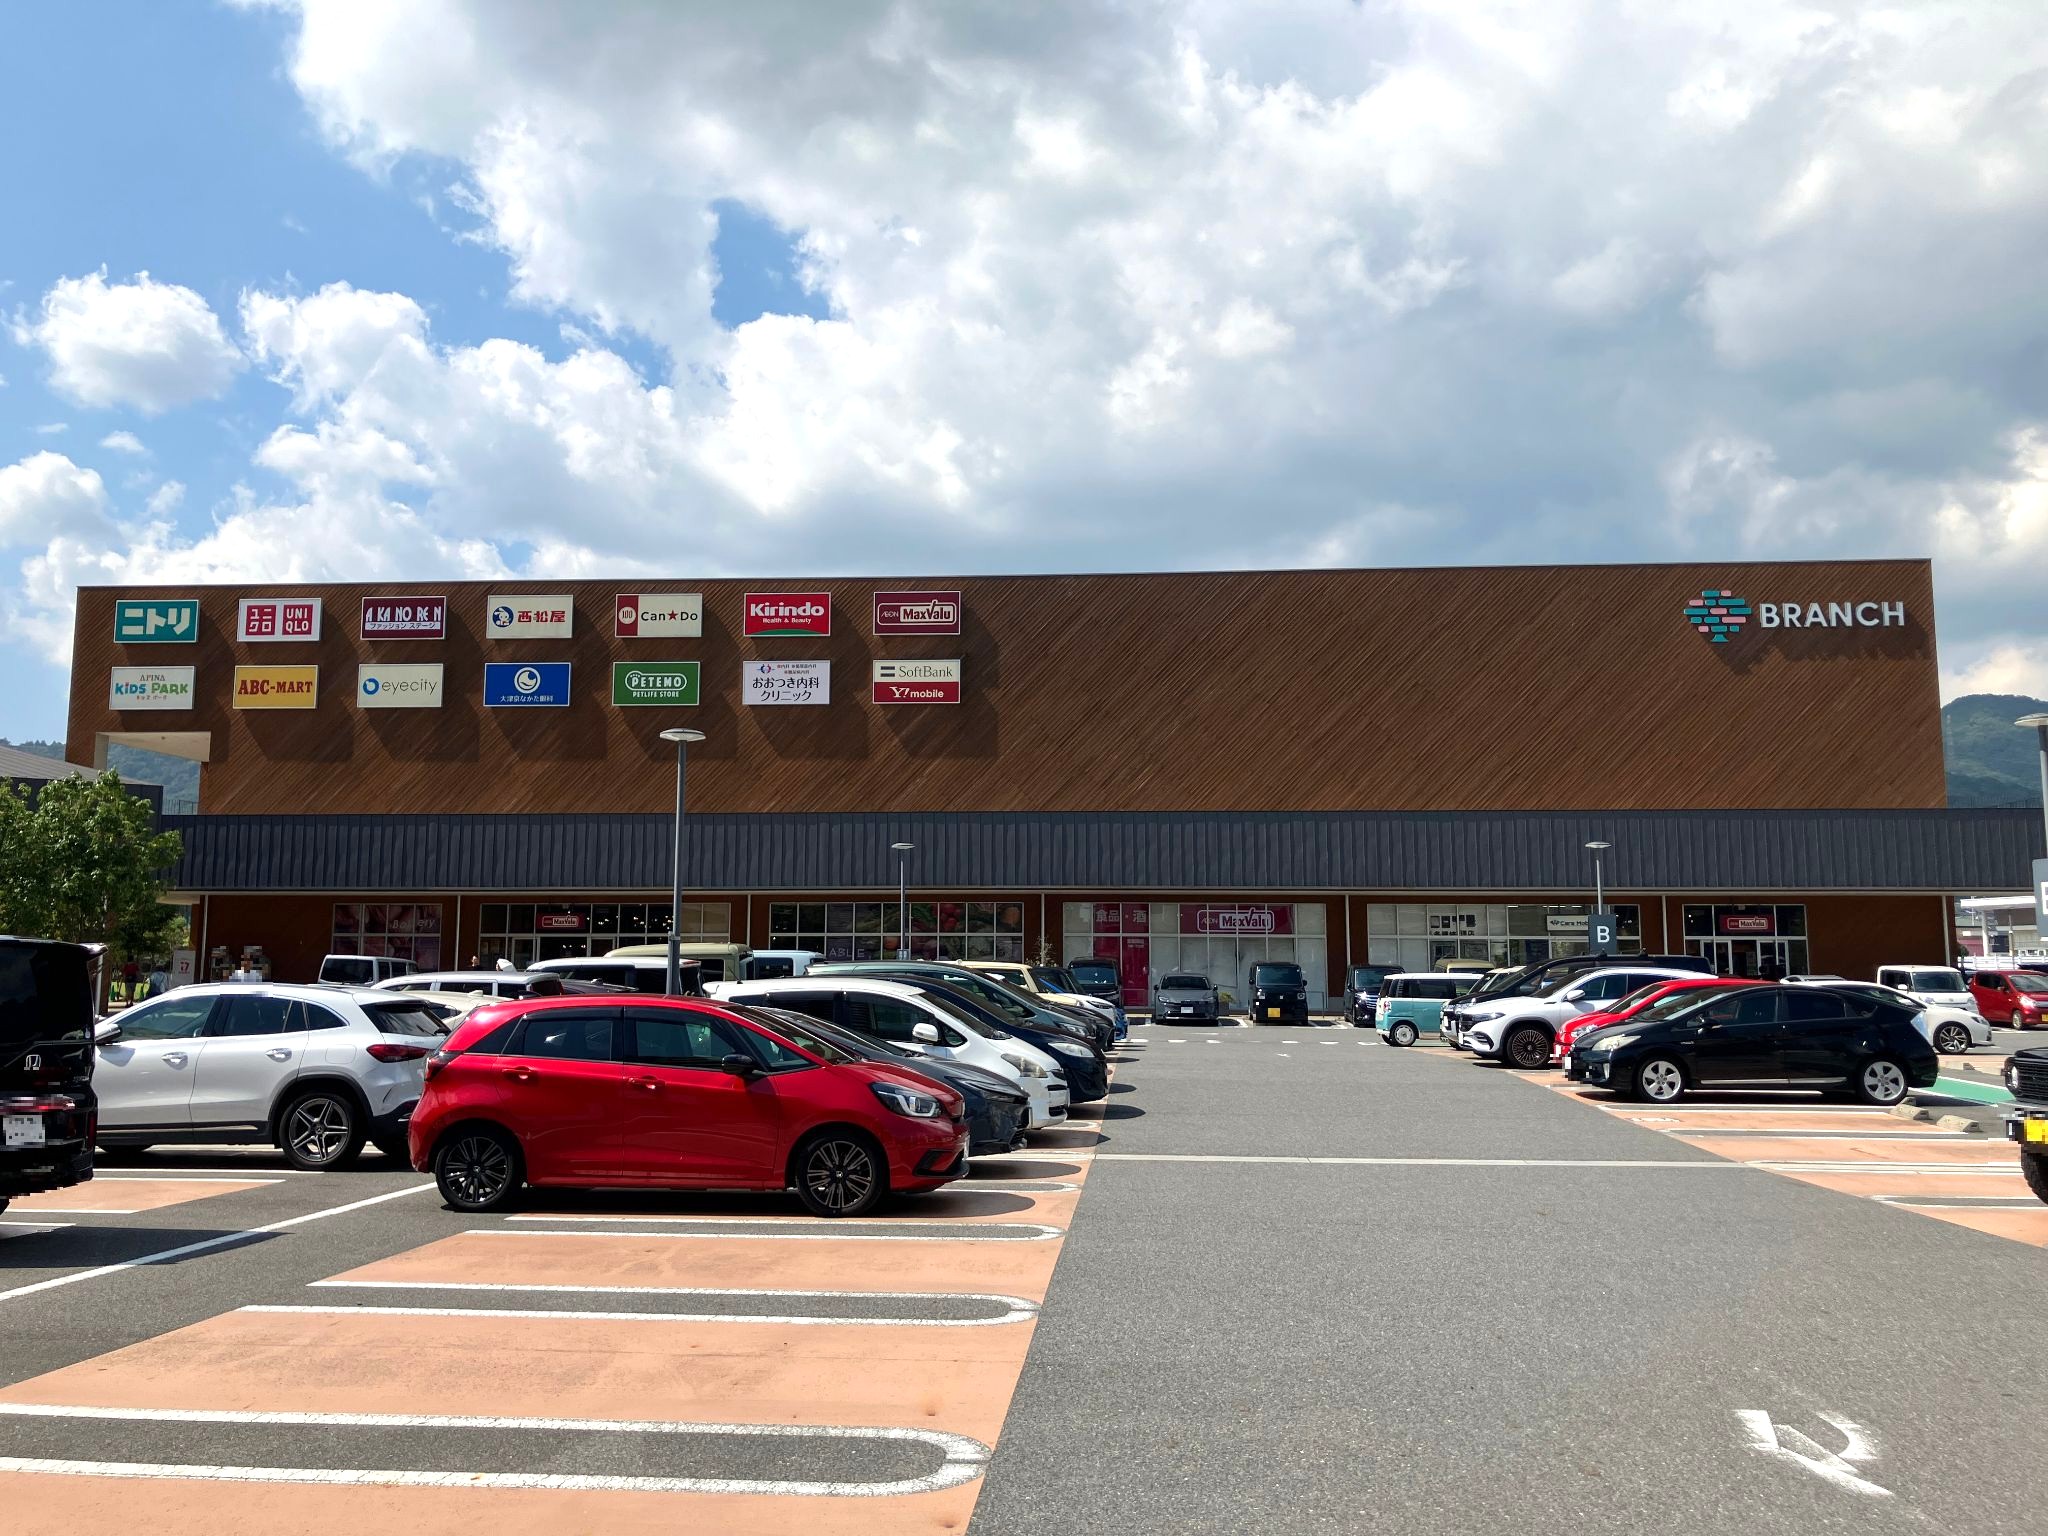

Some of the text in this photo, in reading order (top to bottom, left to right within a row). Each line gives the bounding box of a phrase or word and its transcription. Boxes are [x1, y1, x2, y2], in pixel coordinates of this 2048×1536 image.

[517, 610, 566, 623] 西松屋
[750, 601, 825, 617] Kirindo
[903, 601, 951, 620] MaxValu
[1759, 601, 1905, 628] BRANCH
[122, 607, 190, 635] ニトリ
[899, 665, 953, 678] SoftBank
[151, 682, 189, 695] PARK
[237, 680, 313, 695] ABC-MART
[381, 678, 438, 696] eyecity
[631, 676, 682, 688] PETEMO
[752, 677, 819, 689] おおつき内科
[760, 690, 812, 702] クリニック
[1222, 909, 1269, 927] MaxValu
[1596, 925, 1610, 943] B
